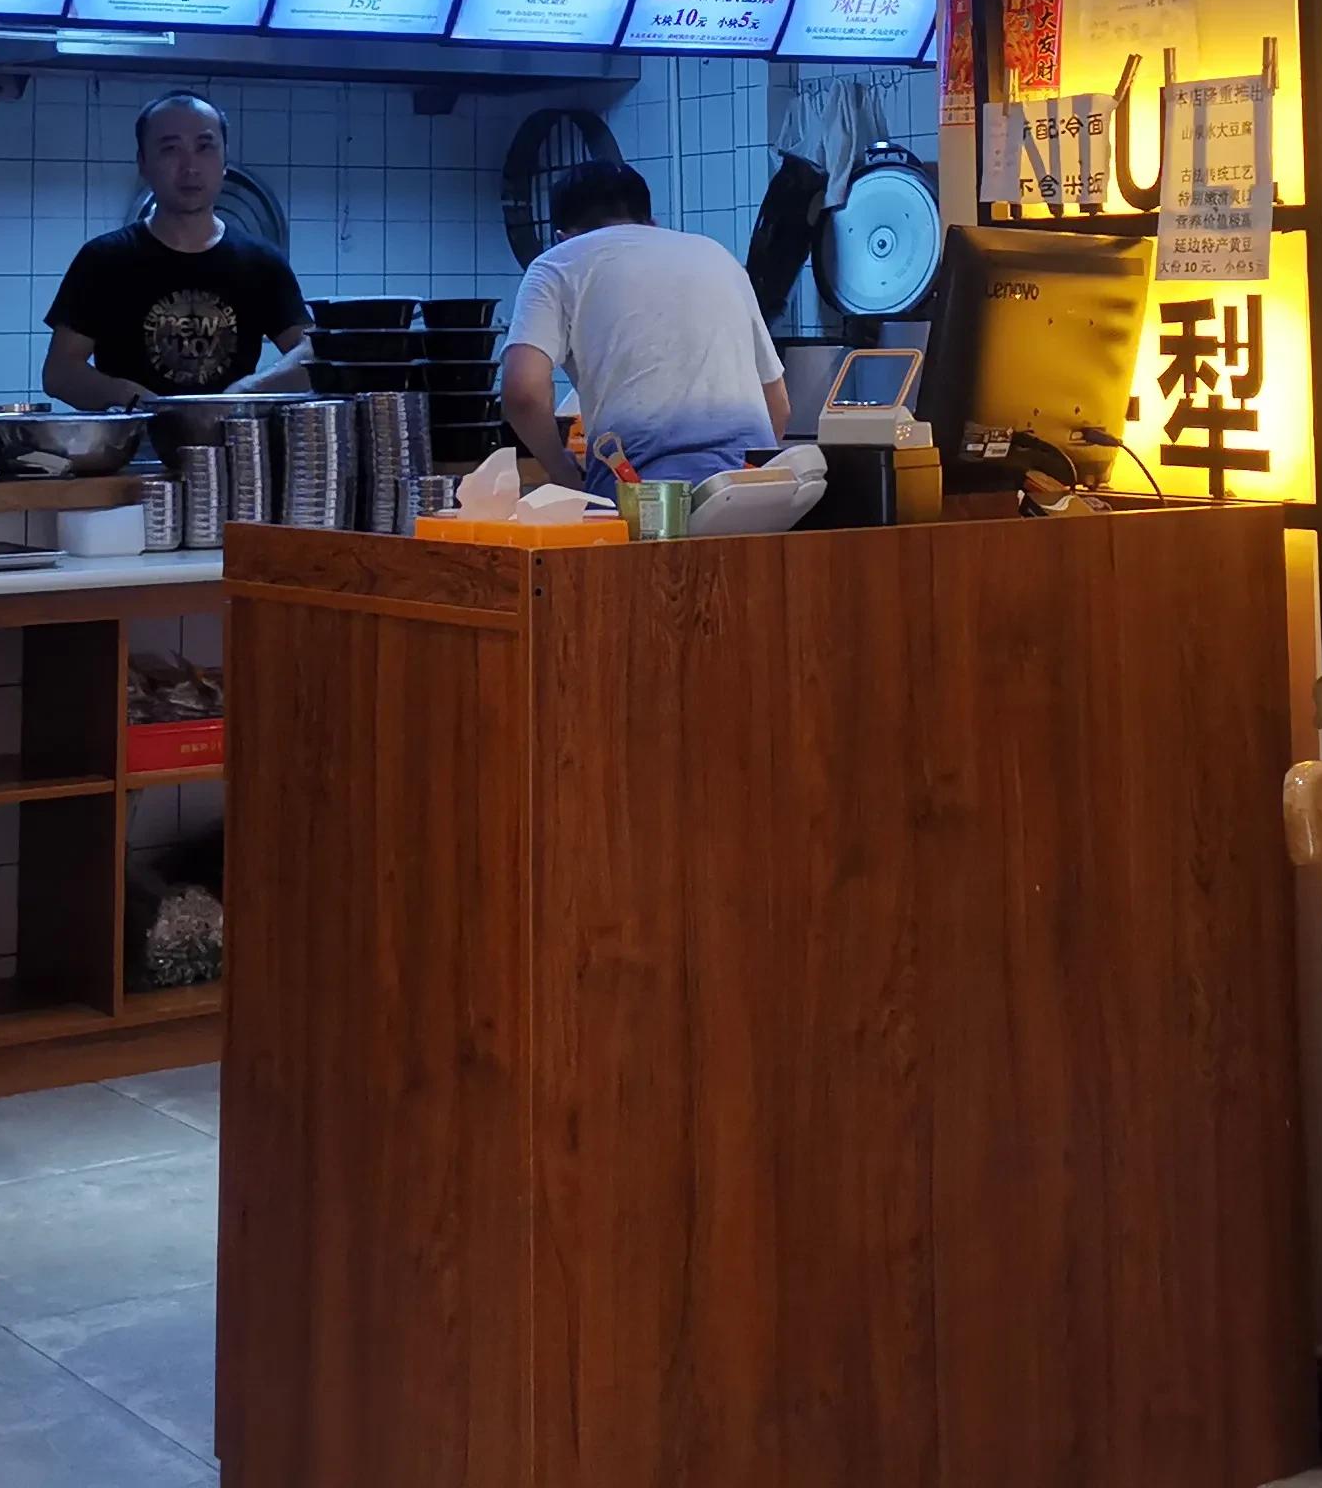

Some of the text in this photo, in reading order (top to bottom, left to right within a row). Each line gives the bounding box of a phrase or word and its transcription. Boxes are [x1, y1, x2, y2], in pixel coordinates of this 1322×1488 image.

[1173, 235, 1253, 254] 延边特产黄豆
[985, 280, 1041, 301] Lenovo
[1157, 294, 1271, 499] 犁
